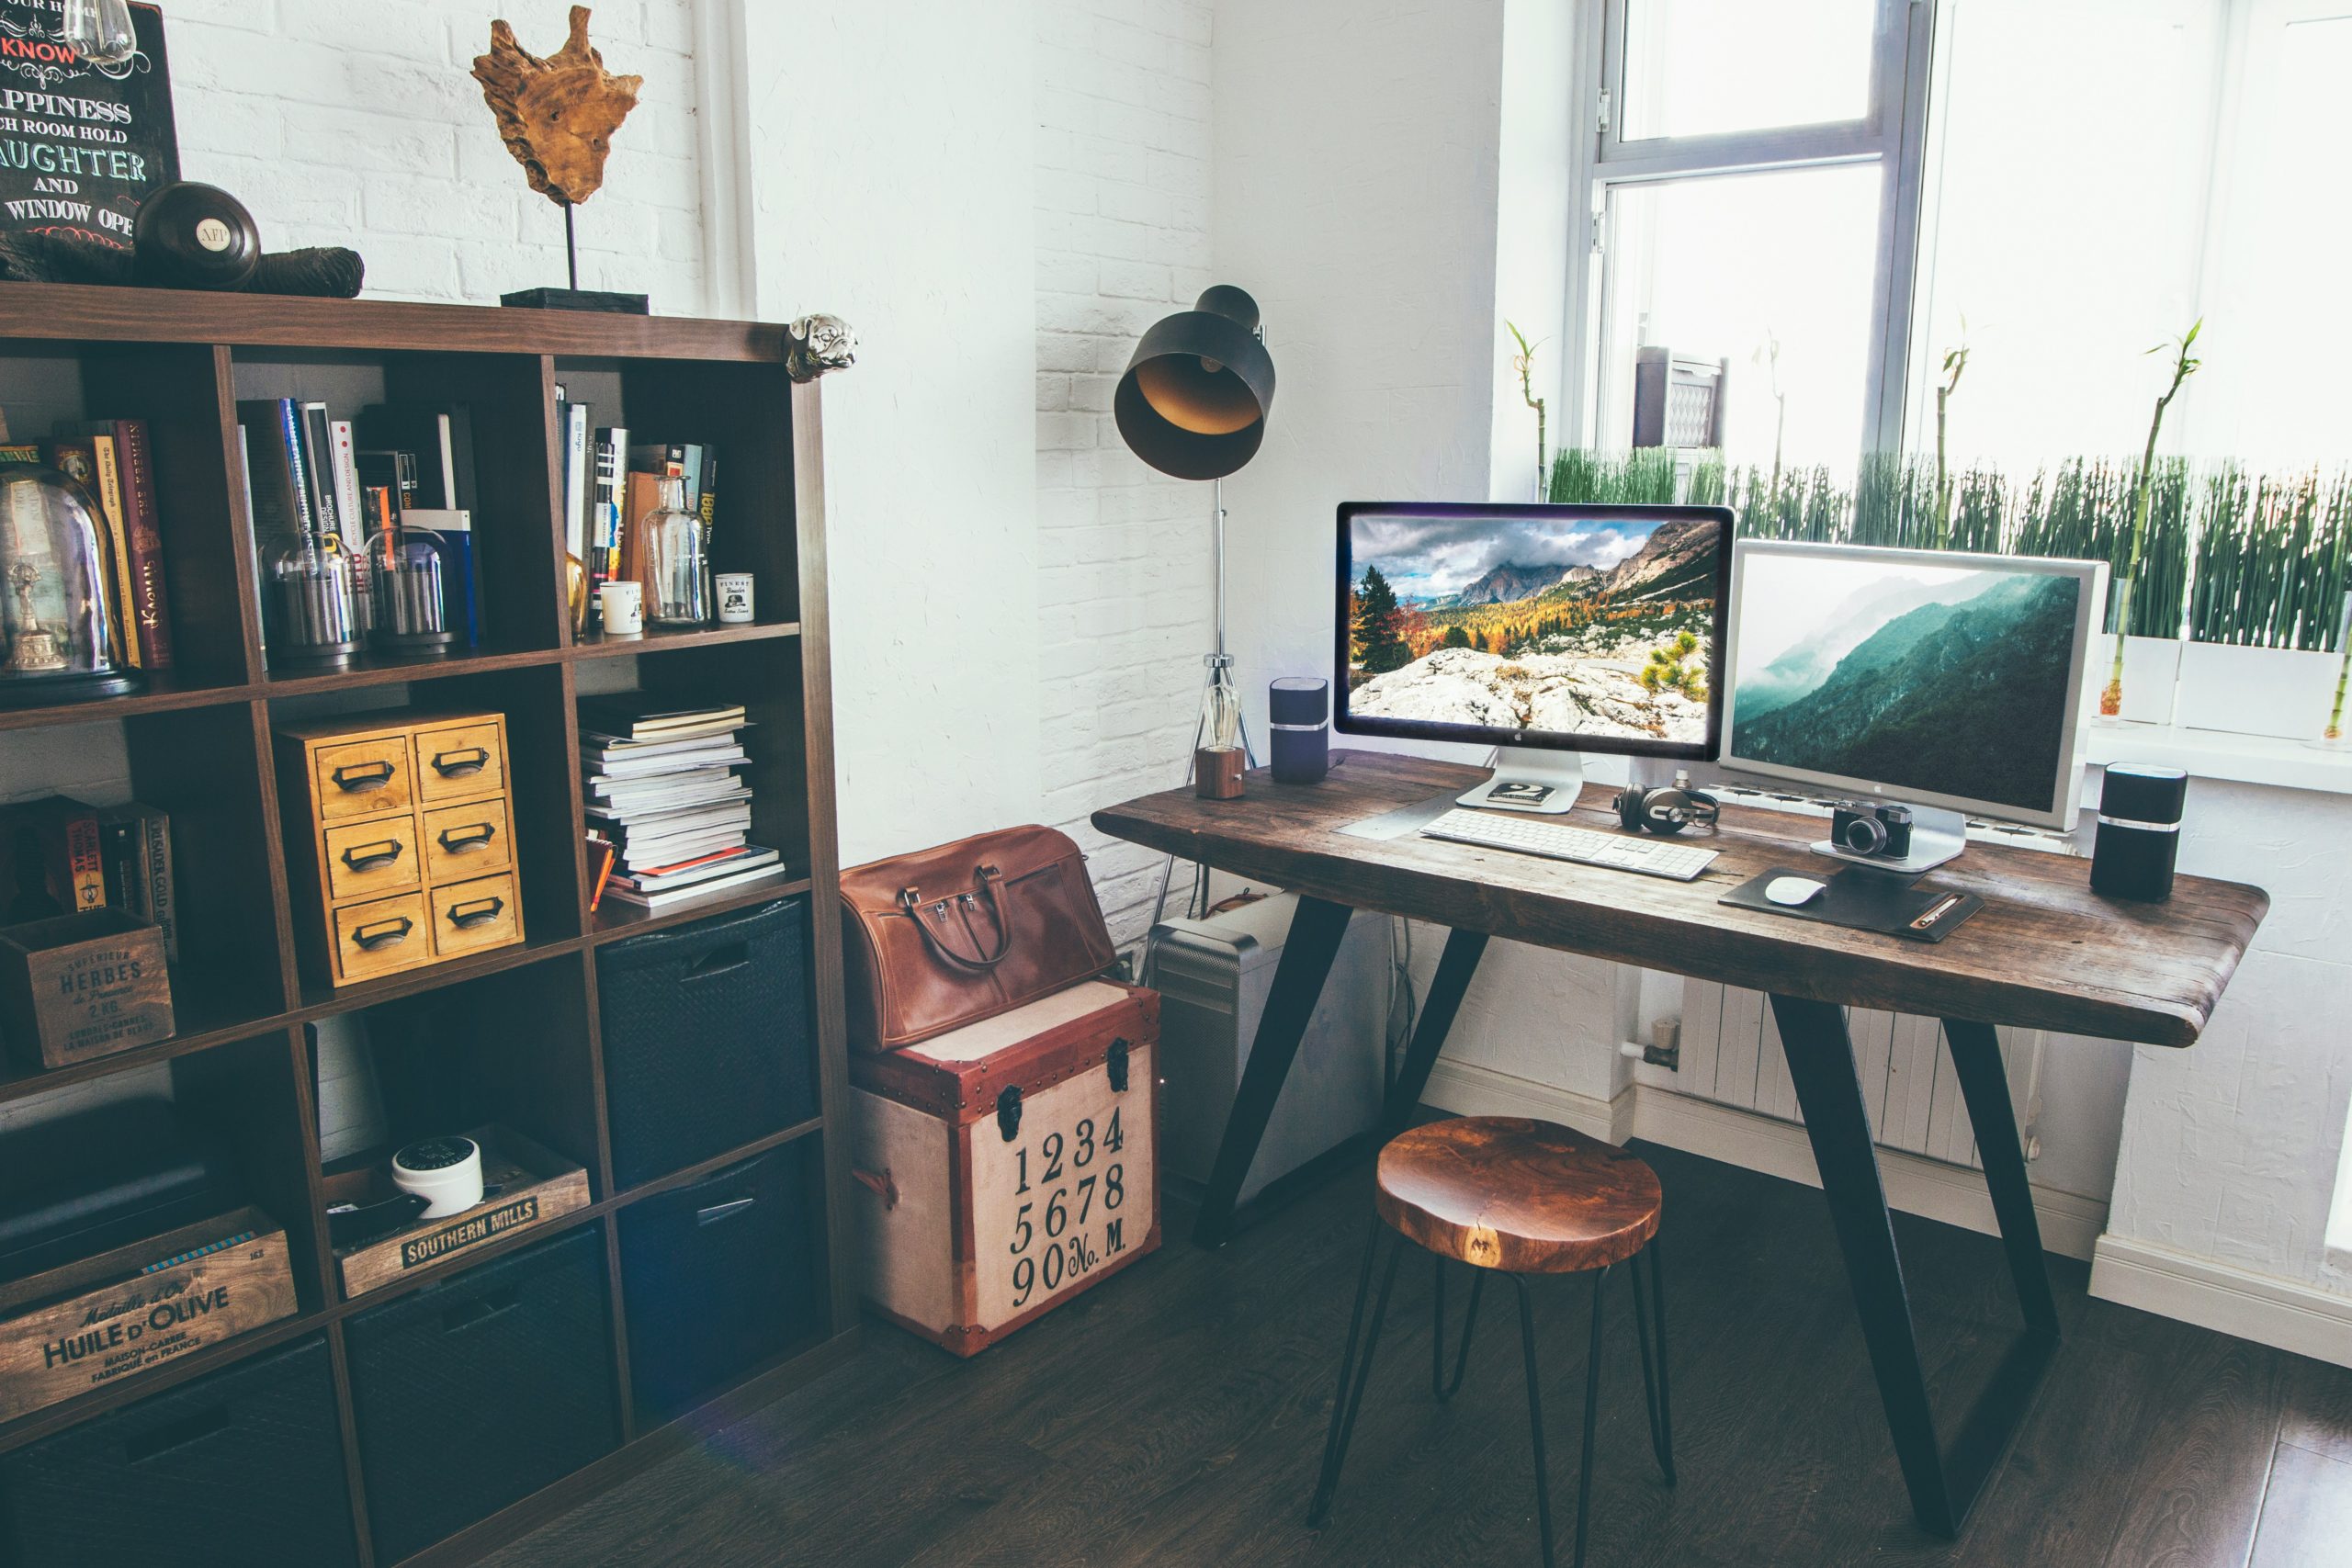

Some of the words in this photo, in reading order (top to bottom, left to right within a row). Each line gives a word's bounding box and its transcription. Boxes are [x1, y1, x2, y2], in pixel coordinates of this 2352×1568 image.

[1, 37, 79, 64] KNOW
[23, 118, 75, 138] ROOM
[80, 126, 128, 144] HOLD
[33, 177, 79, 195] AND
[5, 199, 92, 222] WINDOW
[130, 424, 144, 483] KREMLIN
[343, 453, 351, 477] DESIGN
[137, 491, 149, 516] THE
[324, 494, 336, 532] BROCHURE
[347, 493, 356, 520] CULTURE
[321, 507, 330, 533] DESIGN
[350, 521, 358, 546] BICYCLE
[73, 828, 85, 873] THOMAS
[82, 821, 98, 873] SCARLETT
[151, 819, 164, 876] CRUSADER
[155, 876, 167, 908] GOLD
[59, 961, 141, 994] HERBES
[407, 1218, 487, 1263] SOUTHERN
[490, 1201, 534, 1232] MILLS
[43, 1323, 124, 1369] HUILE
[161, 1336, 201, 1359] FRANCE
